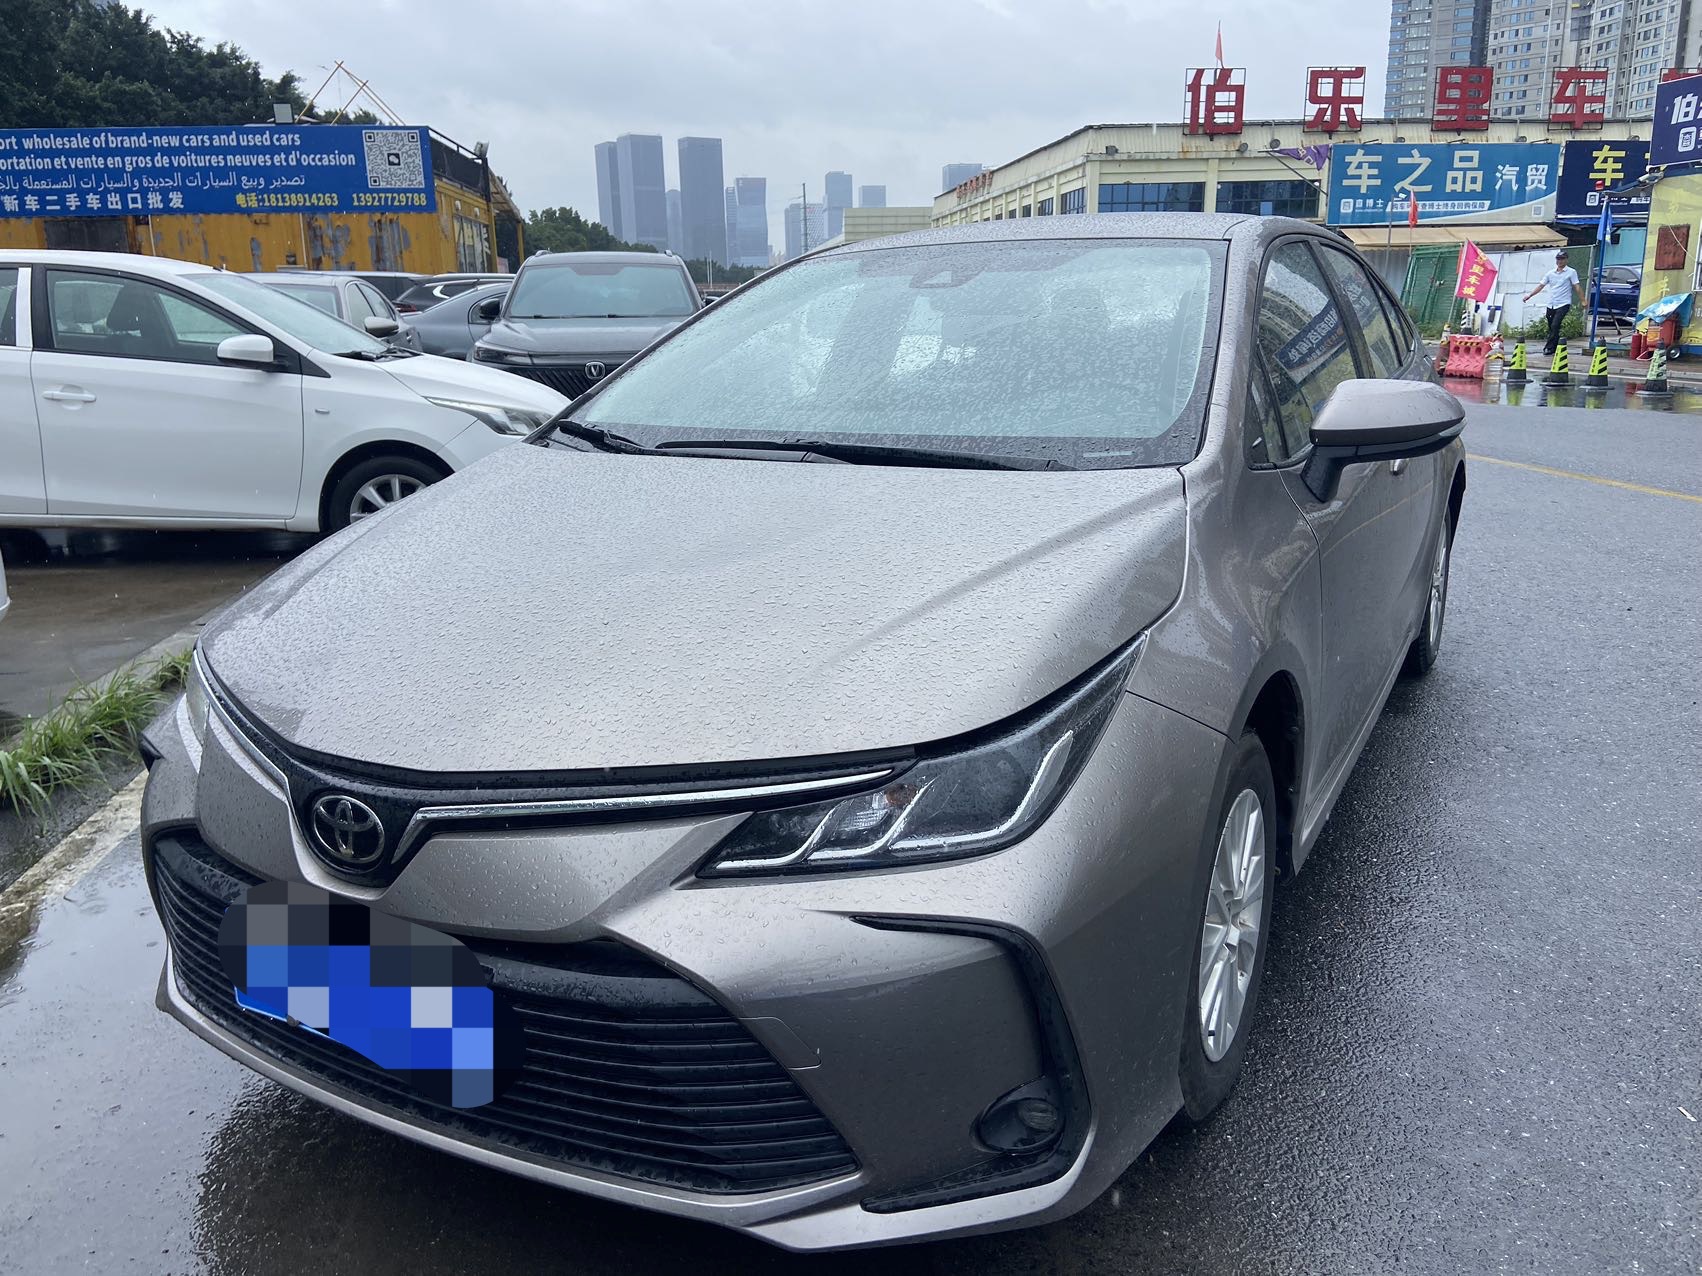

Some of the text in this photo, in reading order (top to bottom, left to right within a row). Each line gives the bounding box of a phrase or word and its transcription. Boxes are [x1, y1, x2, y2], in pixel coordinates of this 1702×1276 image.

[22, 133, 90, 149] wholesale
[92, 132, 106, 148] of
[107, 131, 180, 148] brand-new
[182, 134, 210, 147] cars
[212, 130, 237, 147] and
[239, 130, 271, 146] used
[273, 133, 301, 146] cars
[0, 150, 356, 172] ortation et vente en gros de voitures neuves et d'occasion
[142, 171, 182, 191] الجديدة
[268, 174, 306, 189] تصدير
[1495, 163, 1549, 191] 汽贸
[2, 191, 184, 212] 新车二手车出口批发
[352, 192, 427, 206] 13927729788
